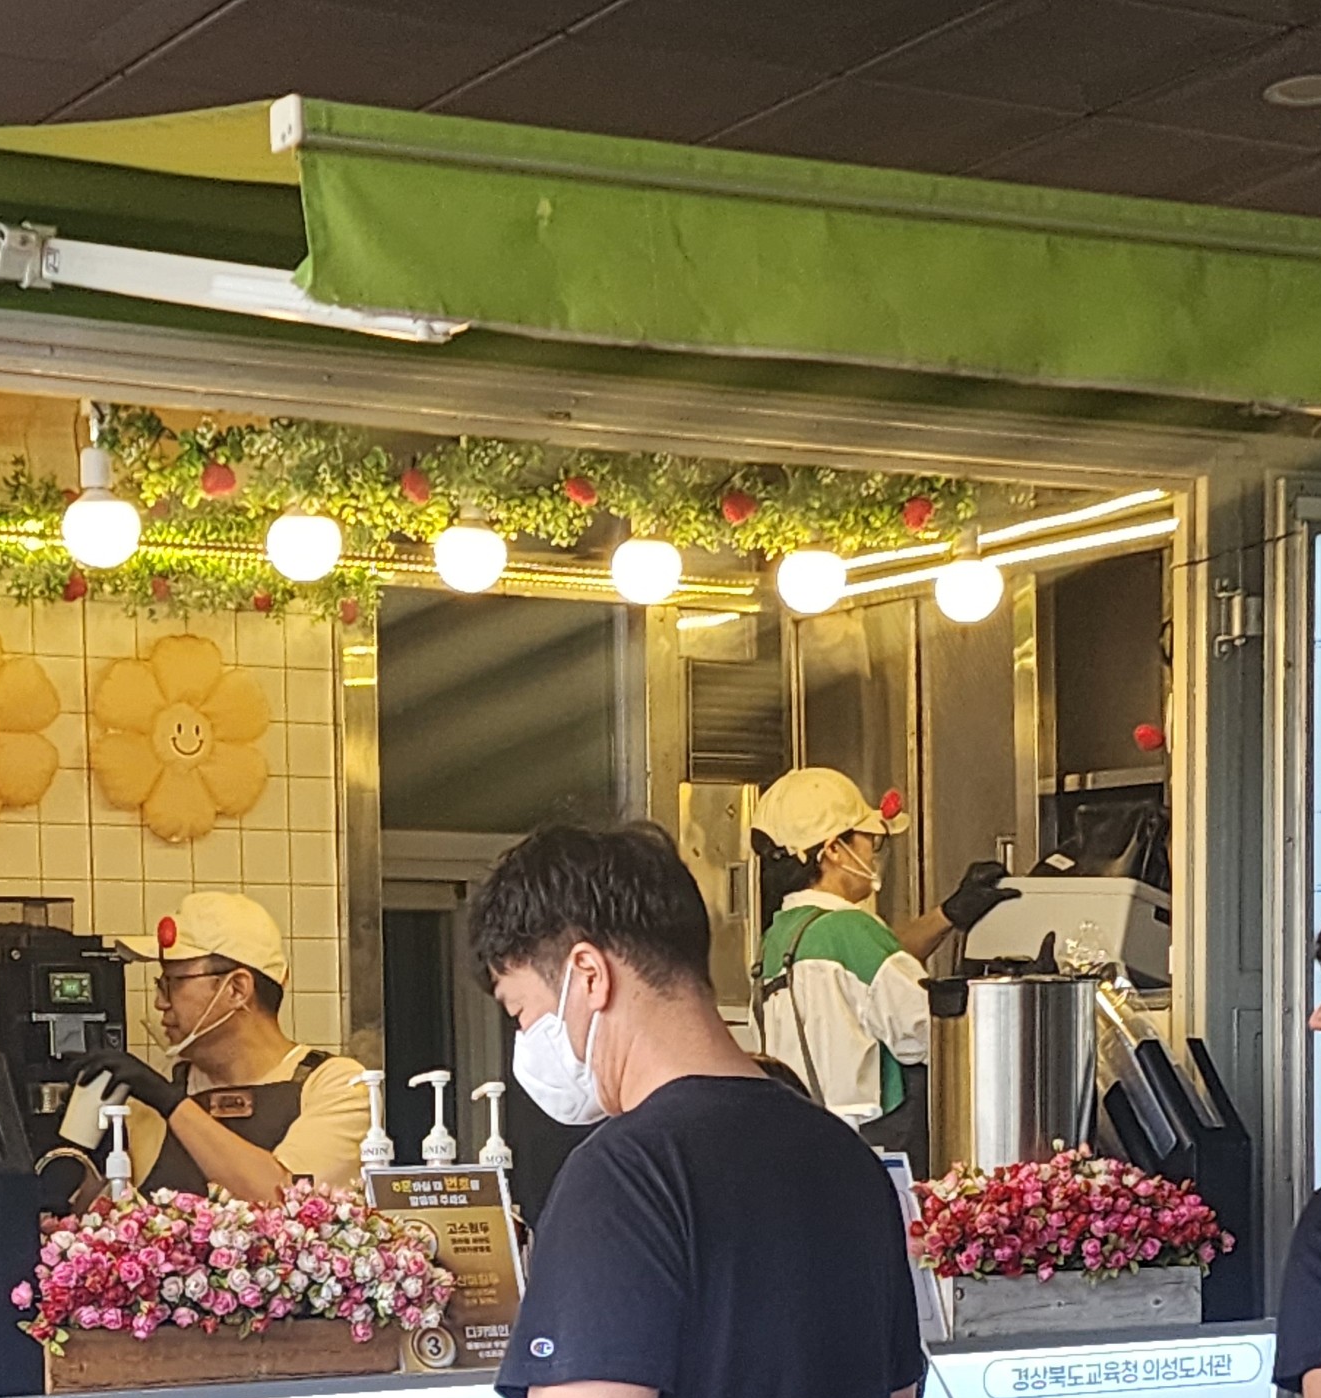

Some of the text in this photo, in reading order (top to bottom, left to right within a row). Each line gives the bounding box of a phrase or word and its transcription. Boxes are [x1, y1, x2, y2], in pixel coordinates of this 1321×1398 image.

[426, 1335, 442, 1357] 3
[1011, 1353, 1233, 1392] 경상북도교육청 의성도서관
